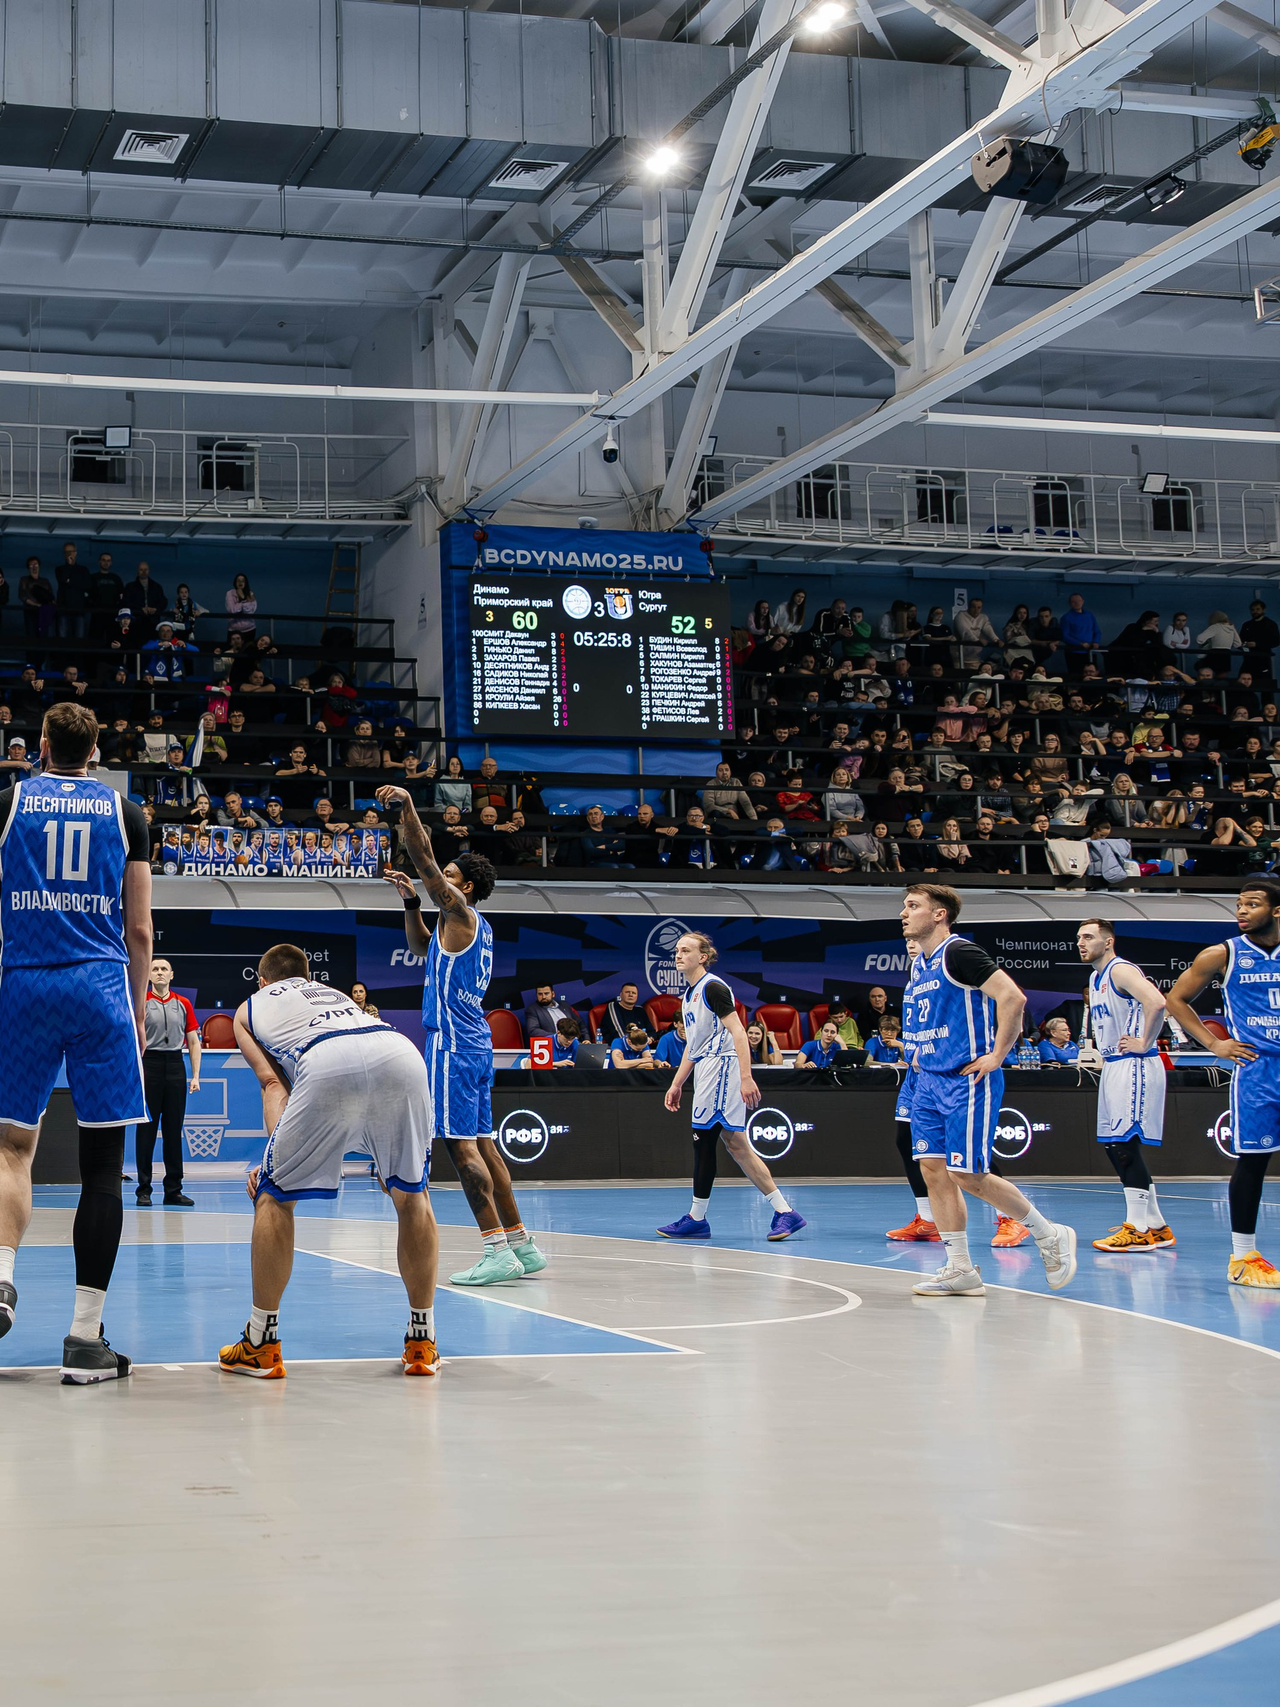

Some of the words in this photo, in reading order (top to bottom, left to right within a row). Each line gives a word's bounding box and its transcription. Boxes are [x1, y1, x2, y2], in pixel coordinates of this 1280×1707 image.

[484, 548, 684, 571] BCDYNAMO25.RU
[473, 584, 510, 595] Динамо
[638, 590, 662, 600] Югра
[473, 596, 530, 608] Приморский
[531, 598, 553, 609] край
[638, 602, 667, 613] Сургут
[594, 602, 605, 617] 3
[485, 610, 494, 622] 3
[512, 610, 538, 630] 60
[671, 616, 696, 634] 52
[704, 618, 713, 629] 5
[484, 638, 510, 646] ЕРШОВ
[573, 631, 632, 648] 05:25:8
[649, 636, 672, 645] БУДИН
[484, 646, 512, 654] ГИНЬКО
[484, 654, 517, 662] ЗАХАРОВ
[519, 655, 540, 663] Павел
[484, 662, 532, 671] ДЕСЯТНИКОВ
[485, 670, 519, 679] САДИКОВ
[520, 671, 548, 679] Николай
[485, 678, 520, 687] ДЕНИСОВ
[684, 676, 706, 685] Сергей
[485, 686, 519, 694] АКСЕНОВ
[573, 683, 580, 692] 0
[626, 685, 633, 694] 0
[652, 692, 688, 700] КУРЦЕВИЧ
[486, 702, 518, 710] КИПКЕЕВ
[652, 699, 680, 707] ПЕЧКИН
[681, 700, 705, 708] Андрей
[686, 716, 709, 724] Сергей
[22, 795, 113, 816] ДЕСЯТНИКОВ
[42, 820, 91, 881] 10
[182, 863, 268, 877] ДИНАМО
[282, 864, 374, 878] МАШИНА!
[11, 890, 116, 915] ВЛАДИВОСТОК
[996, 937, 1074, 953] Чемпионат
[996, 957, 1050, 969] России
[533, 1040, 550, 1065] 5
[505, 1128, 542, 1143] РФБ
[752, 1126, 788, 1141] РФБ
